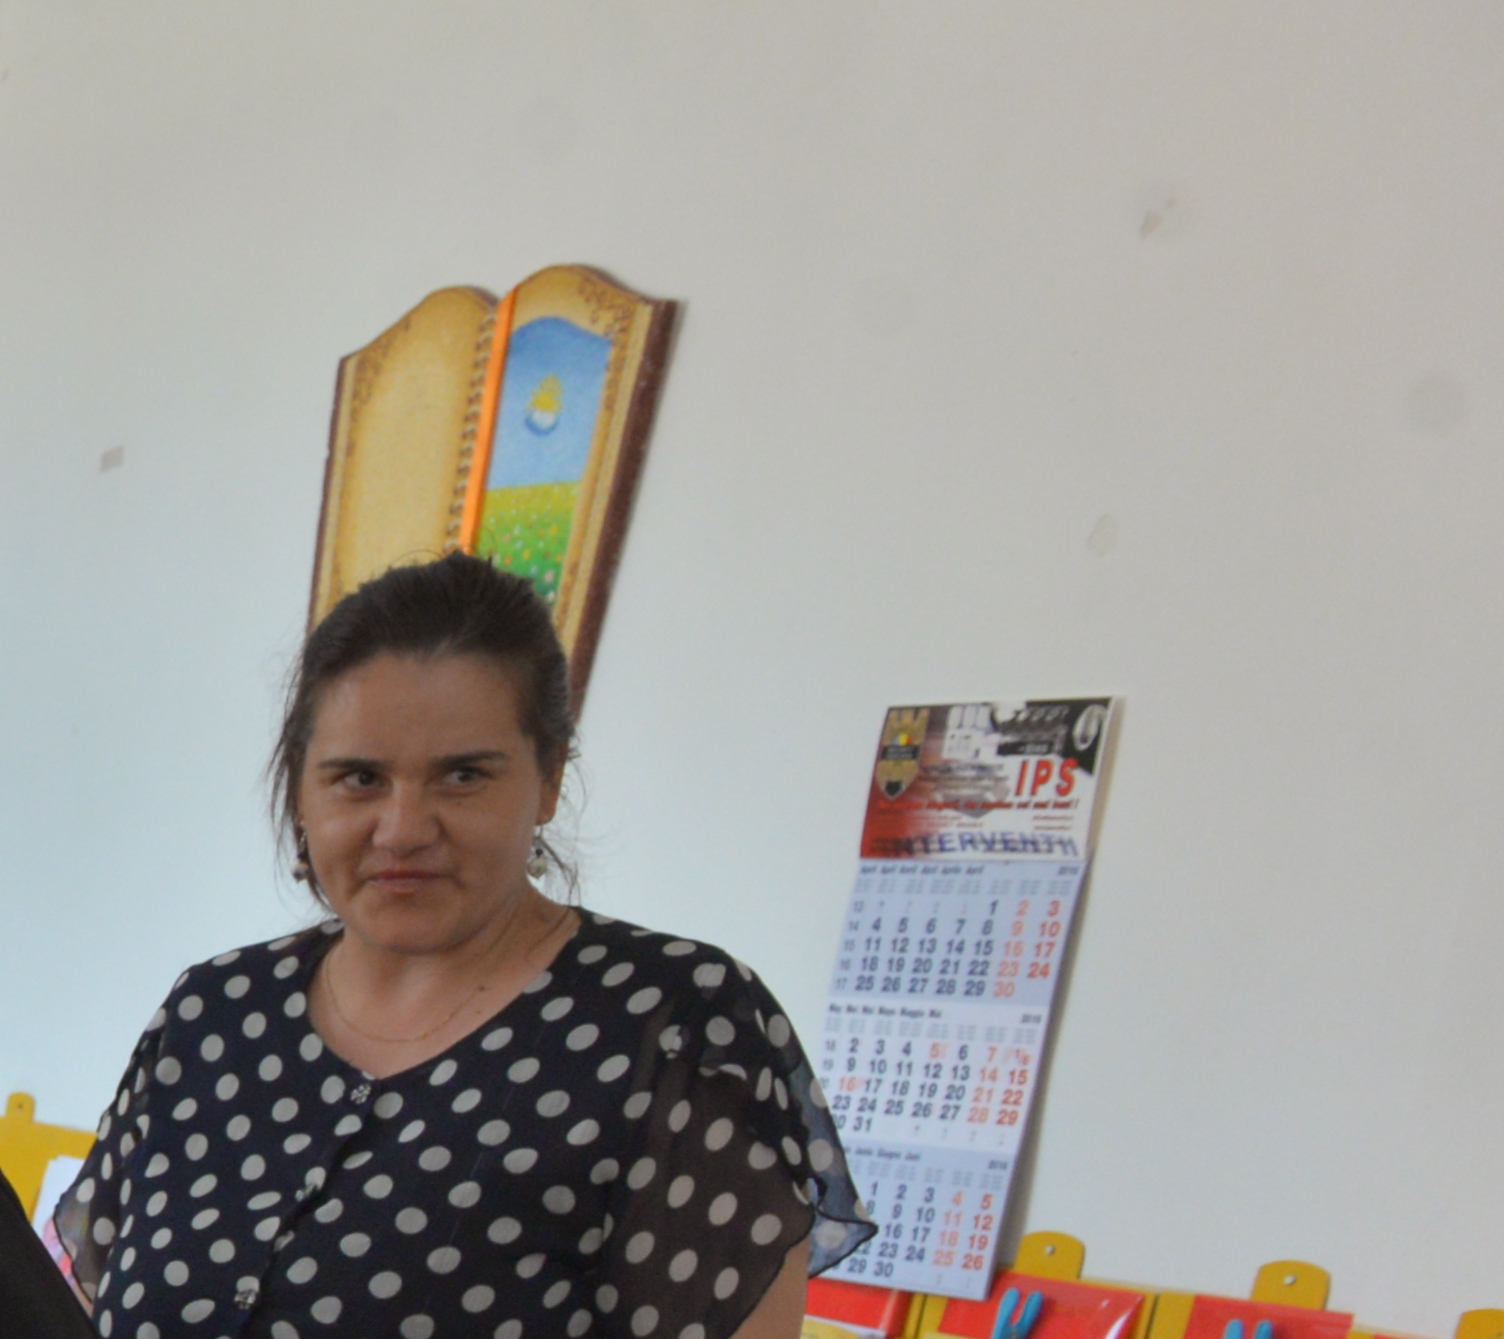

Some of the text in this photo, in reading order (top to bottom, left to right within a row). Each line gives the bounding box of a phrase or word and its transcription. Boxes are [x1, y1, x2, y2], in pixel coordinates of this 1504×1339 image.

[1014, 757, 1079, 797] IPS
[989, 899, 999, 916] 1
[1016, 899, 1029, 916] 2
[1047, 900, 1060, 916] 3
[871, 917, 881, 933] 4
[898, 917, 909, 934] 5
[926, 917, 937, 934] 6
[955, 918, 966, 934] 7
[981, 919, 993, 935] 8
[1012, 920, 1024, 937] 9
[1039, 921, 1061, 938] 10
[865, 936, 881, 952] 11
[891, 937, 909, 953] 12
[918, 938, 938, 954] 13
[946, 939, 966, 955] 14
[974, 940, 994, 956] 15
[1003, 940, 1025, 957] 16
[1034, 942, 1056, 958] 17
[861, 956, 878, 972] 18
[888, 957, 905, 973] 19
[912, 958, 932, 975] 20
[939, 959, 960, 975] 21
[968, 960, 990, 977] 22
[997, 961, 1020, 978] 23
[1027, 962, 1050, 979] 24
[855, 975, 874, 992] 25
[881, 976, 901, 993] 26
[908, 977, 929, 994] 27
[936, 978, 957, 996] 28
[963, 979, 986, 997] 29
[993, 981, 1016, 998] 30
[849, 1037, 859, 1053] 2
[875, 1039, 885, 1055] 3
[902, 1041, 912, 1056] 4
[958, 1045, 969, 1061] 6
[987, 1046, 998, 1062] 7
[846, 1057, 856, 1072] 9
[869, 1058, 888, 1074] 10
[896, 1061, 913, 1077] 11
[923, 1062, 943, 1079] 12
[951, 1064, 971, 1081] 13
[979, 1066, 999, 1083] 14
[1009, 1068, 1029, 1086] 15
[838, 1075, 857, 1092] 16
[864, 1077, 884, 1094] 17
[890, 1080, 911, 1097] 18
[919, 1082, 939, 1099] 19
[944, 1084, 966, 1101] 20
[972, 1086, 994, 1103] 21
[1001, 1088, 1024, 1106] 22
[831, 1094, 1020, 1126] 23 24 25 26 27 28 29
[852, 1116, 873, 1133] 31
[871, 1181, 994, 1210] 1 2 3 4 5
[891, 1203, 903, 1219] 9
[916, 1206, 936, 1223] 10
[944, 1210, 963, 1226] 11
[973, 1214, 993, 1231] 12
[885, 1223, 989, 1250] 16 17 18 19
[847, 1257, 895, 1278] 29 30
[878, 1241, 898, 1259] 23
[905, 1245, 926, 1262] 24
[932, 1249, 955, 1267] 25
[961, 1253, 984, 1271] 26
